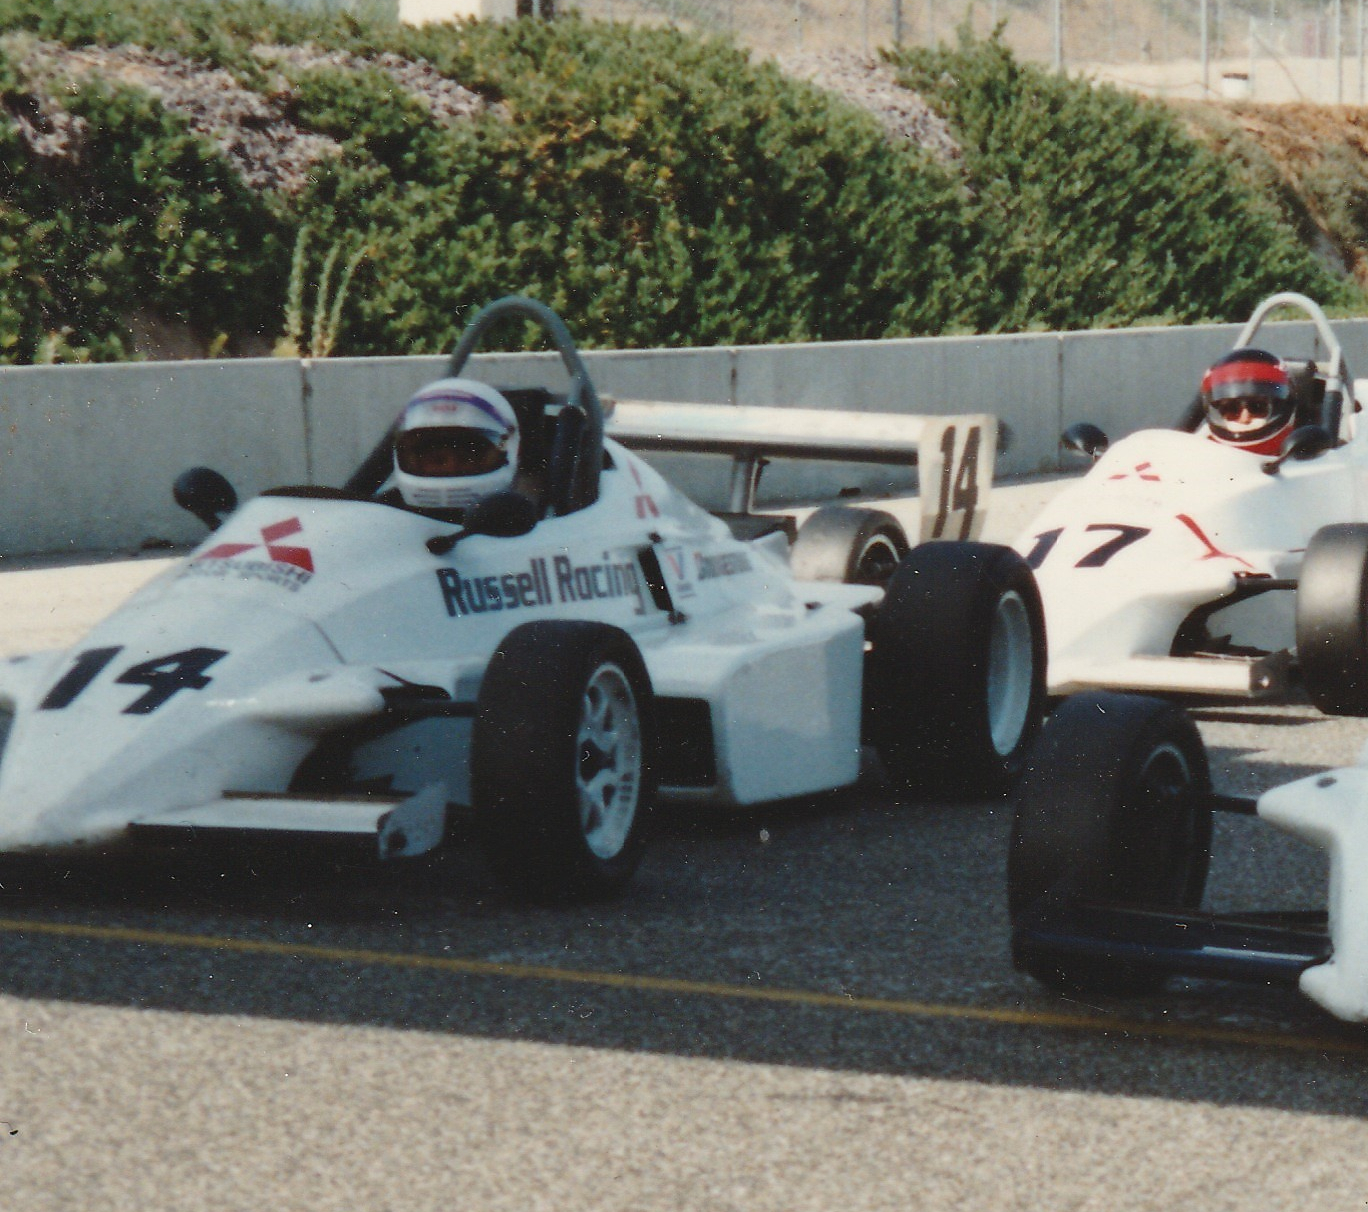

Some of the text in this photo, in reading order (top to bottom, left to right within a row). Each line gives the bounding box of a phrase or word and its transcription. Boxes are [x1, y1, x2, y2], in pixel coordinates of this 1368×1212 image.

[931, 424, 981, 541] 14
[1025, 523, 1152, 570] 17
[436, 557, 552, 617] Russell
[553, 551, 646, 615] Racing
[38, 645, 228, 714] 14
